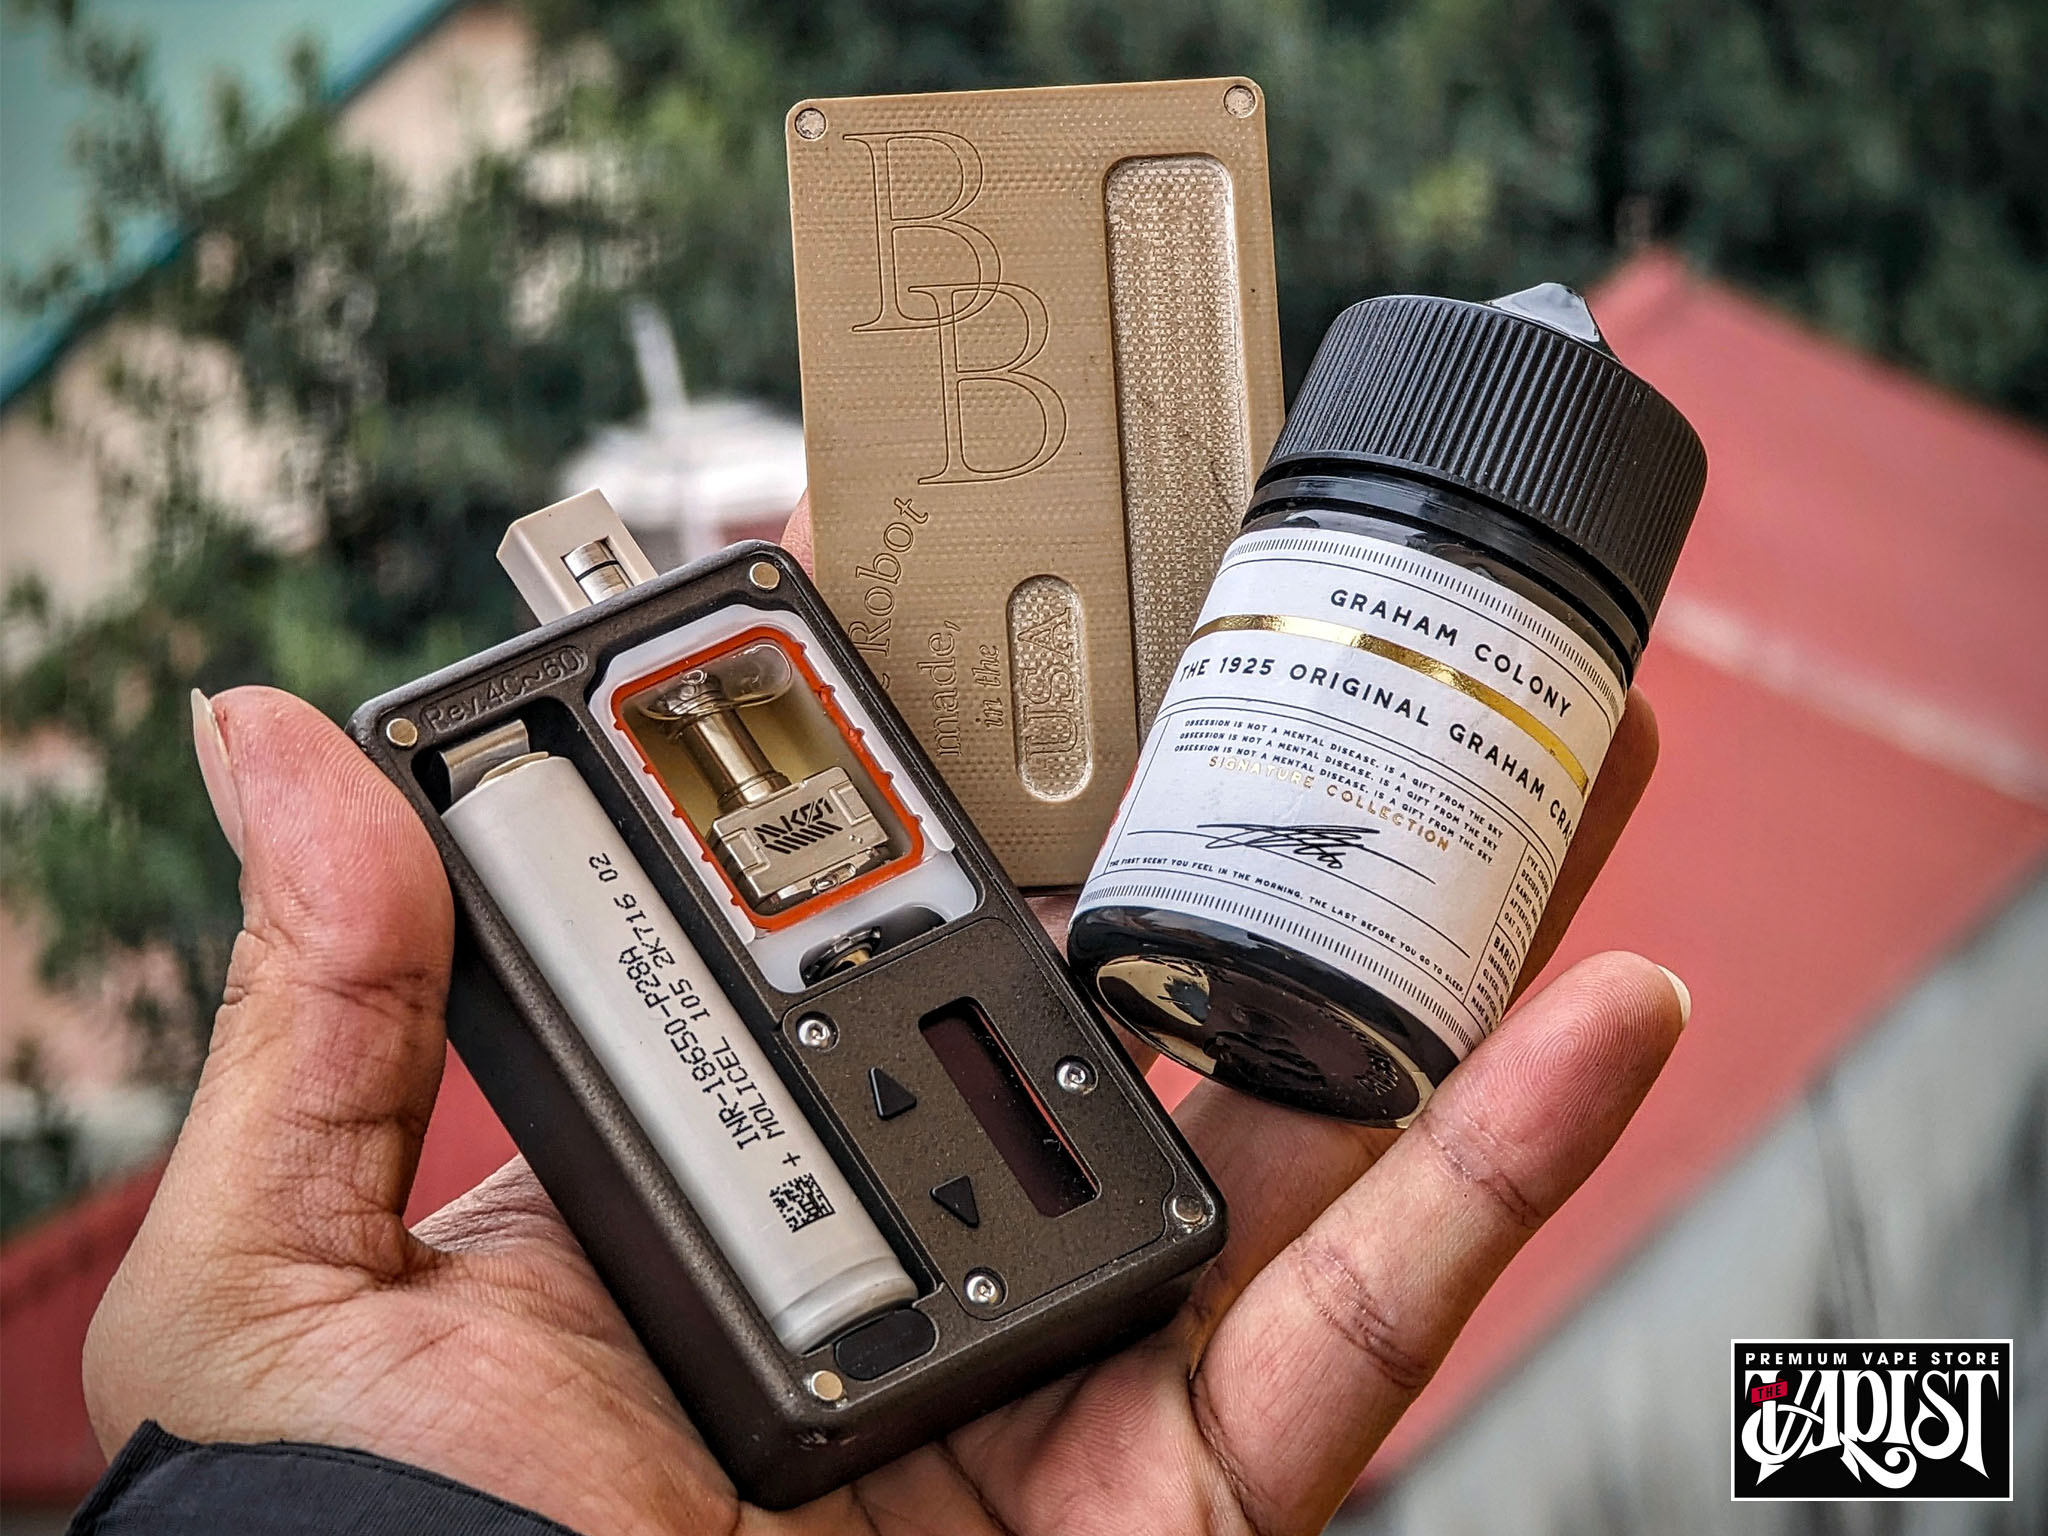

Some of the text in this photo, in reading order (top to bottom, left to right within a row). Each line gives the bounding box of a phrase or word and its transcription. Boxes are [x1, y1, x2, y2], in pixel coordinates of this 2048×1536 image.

[847, 497, 929, 657] Robot
[917, 620, 962, 757] made,
[971, 643, 1005, 730] in the
[1017, 607, 1078, 761] USA
[1330, 589, 1572, 718] GRAHAM COLONY
[1179, 658, 1211, 683] THE
[1219, 656, 1276, 676] 1925
[1289, 663, 1430, 727] ORIGINAL
[1449, 723, 1546, 802] GRAHAM
[1184, 718, 1231, 728] OBSESSION
[1233, 720, 1243, 728] IS
[1247, 723, 1268, 732] NOT
[1283, 728, 1325, 747] MENTAL
[1384, 764, 1395, 774] IS
[1400, 772, 1407, 780] A
[1412, 777, 1436, 794] GIFT
[1438, 791, 1466, 812] FROM
[1469, 809, 1486, 825] THE
[1487, 823, 1504, 838] SKY
[1174, 744, 1220, 752] OBSESSION
[1236, 748, 1257, 757] NOT
[1260, 752, 1267, 760] A
[1272, 755, 1314, 772] MENTAL
[1374, 790, 1385, 799] IS
[1389, 797, 1396, 806] A
[1401, 803, 1425, 820] GIFT
[1428, 817, 1455, 838] FROM
[1458, 835, 1475, 851] THE
[1477, 849, 1493, 864] SKY
[1179, 732, 1226, 740] OBSESSION
[1228, 733, 1238, 741] IS
[1242, 735, 1263, 745] NOT
[1277, 742, 1320, 760] MENTAL
[1379, 777, 1390, 787] IS
[1394, 785, 1401, 793] A
[1406, 790, 1430, 807] GIFT
[1433, 804, 1460, 825] FROM
[1463, 822, 1480, 838] THE
[1482, 836, 1499, 852] SKY
[1209, 756, 1449, 851] SIGNATURE COLLECTION
[589, 852, 618, 883] 02
[1121, 857, 1140, 865] FIRST
[1142, 857, 1168, 865] SCENT
[1171, 858, 1189, 867] YOU
[1191, 862, 1213, 872] FEEL
[1218, 867, 1228, 875] IN
[1232, 870, 1251, 882] THE
[1309, 896, 1327, 909] THE
[1331, 905, 1358, 923] LAST
[1360, 920, 1397, 944] BEFORE
[1400, 940, 1417, 956] YOU
[1419, 954, 1430, 966] GO
[1433, 963, 1443, 975] TO
[1504, 912, 1516, 928] OAT
[618, 945, 761, 1150] INR-18650-P28A
[668, 978, 711, 1021] 105
[712, 1035, 786, 1141] MOLICEL
